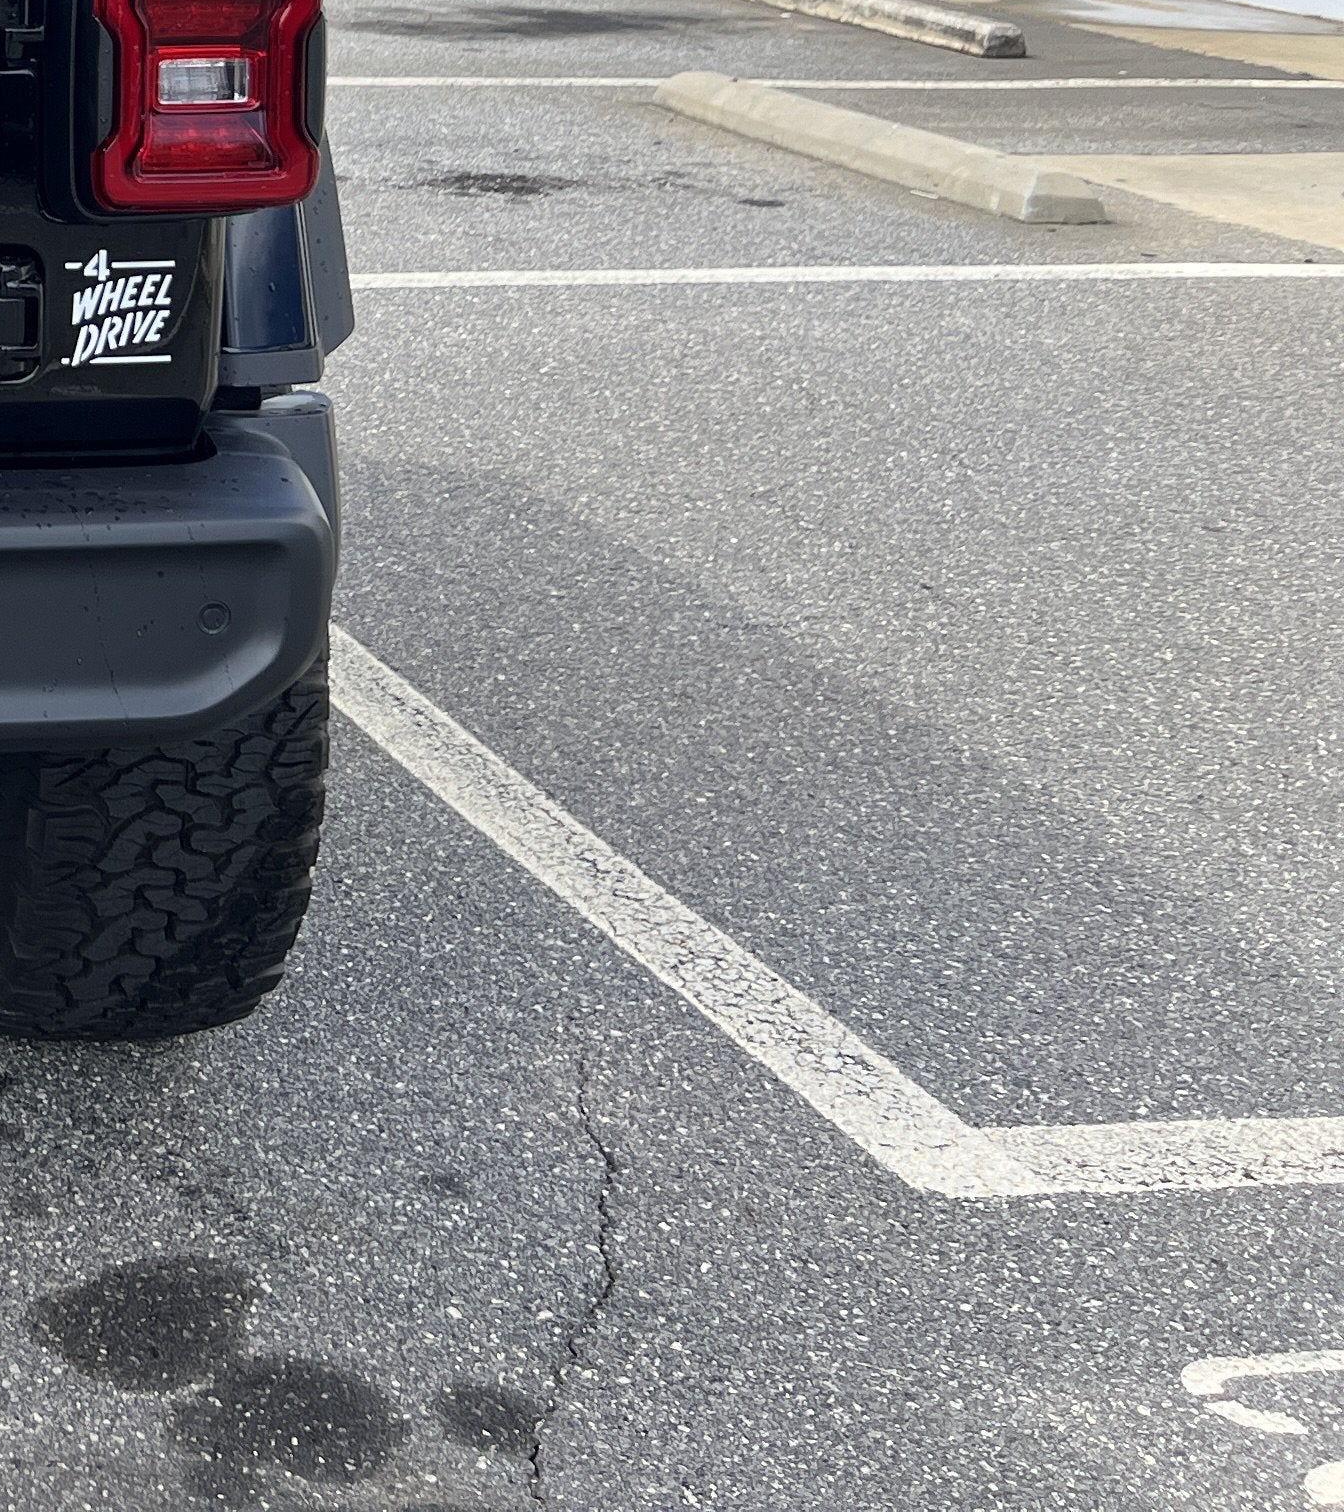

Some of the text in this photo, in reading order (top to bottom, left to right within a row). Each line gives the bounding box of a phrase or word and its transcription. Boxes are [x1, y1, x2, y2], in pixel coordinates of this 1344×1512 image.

[83, 249, 111, 281] 4
[72, 274, 174, 326] WHEEL
[71, 310, 171, 367] DRIVE
